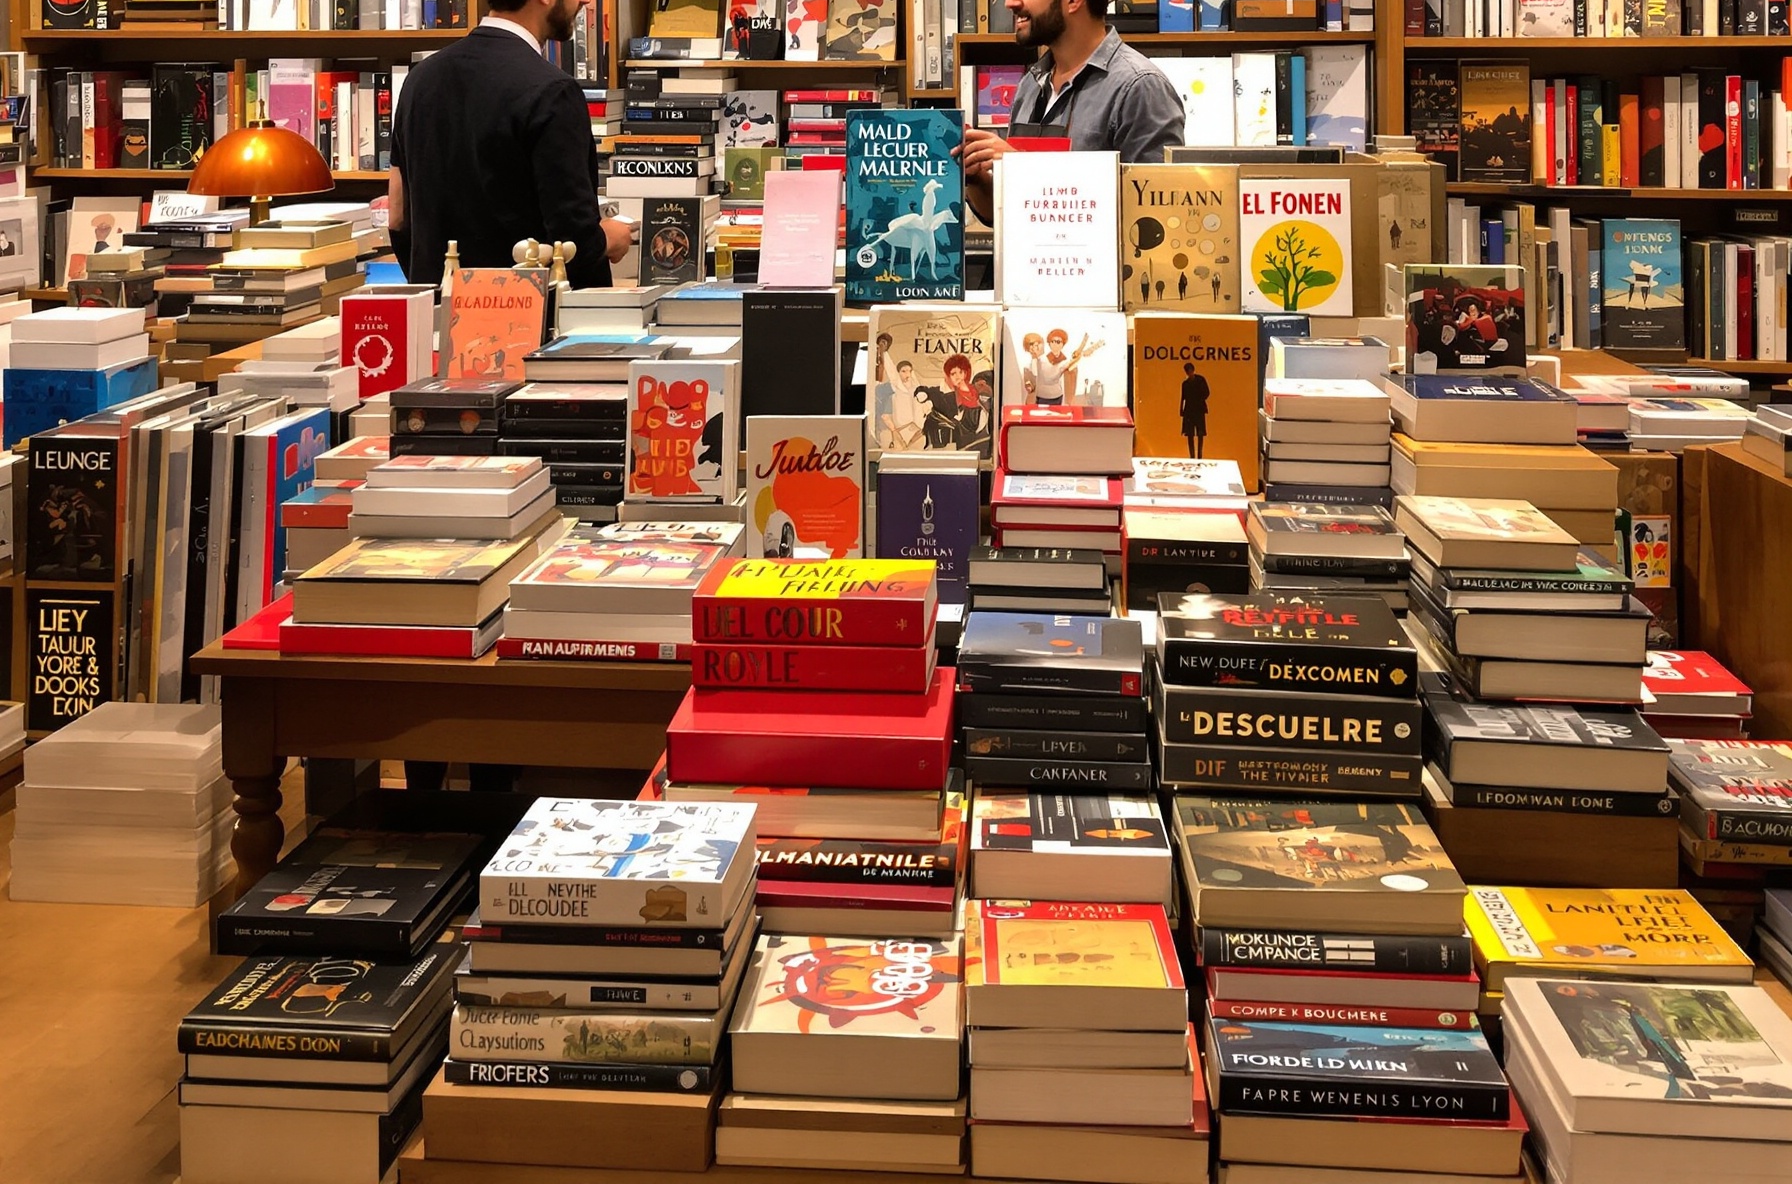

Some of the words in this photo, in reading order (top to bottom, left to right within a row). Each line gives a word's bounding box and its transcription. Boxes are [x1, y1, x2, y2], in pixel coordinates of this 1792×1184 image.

[858, 123, 912, 140] MALD
[864, 142, 929, 158] LECUER
[859, 160, 949, 177] MALRNLE
[1243, 192, 1265, 215] EL
[1271, 191, 1342, 215] FONEN
[896, 287, 930, 298] LOON
[35, 450, 112, 471] LEUNGE
[764, 606, 845, 639] COUR
[36, 655, 82, 675] YORE
[86, 656, 99, 676] &
[1178, 654, 1214, 668] NEW
[1268, 663, 1381, 684] DEXCOMEN
[35, 675, 100, 696] DOOKS
[1193, 710, 1383, 744] DESCUELRE
[1230, 1004, 1288, 1018] COMPE
[470, 1063, 551, 1084] FRIOFERS
[1411, 1095, 1465, 1110] LYON
